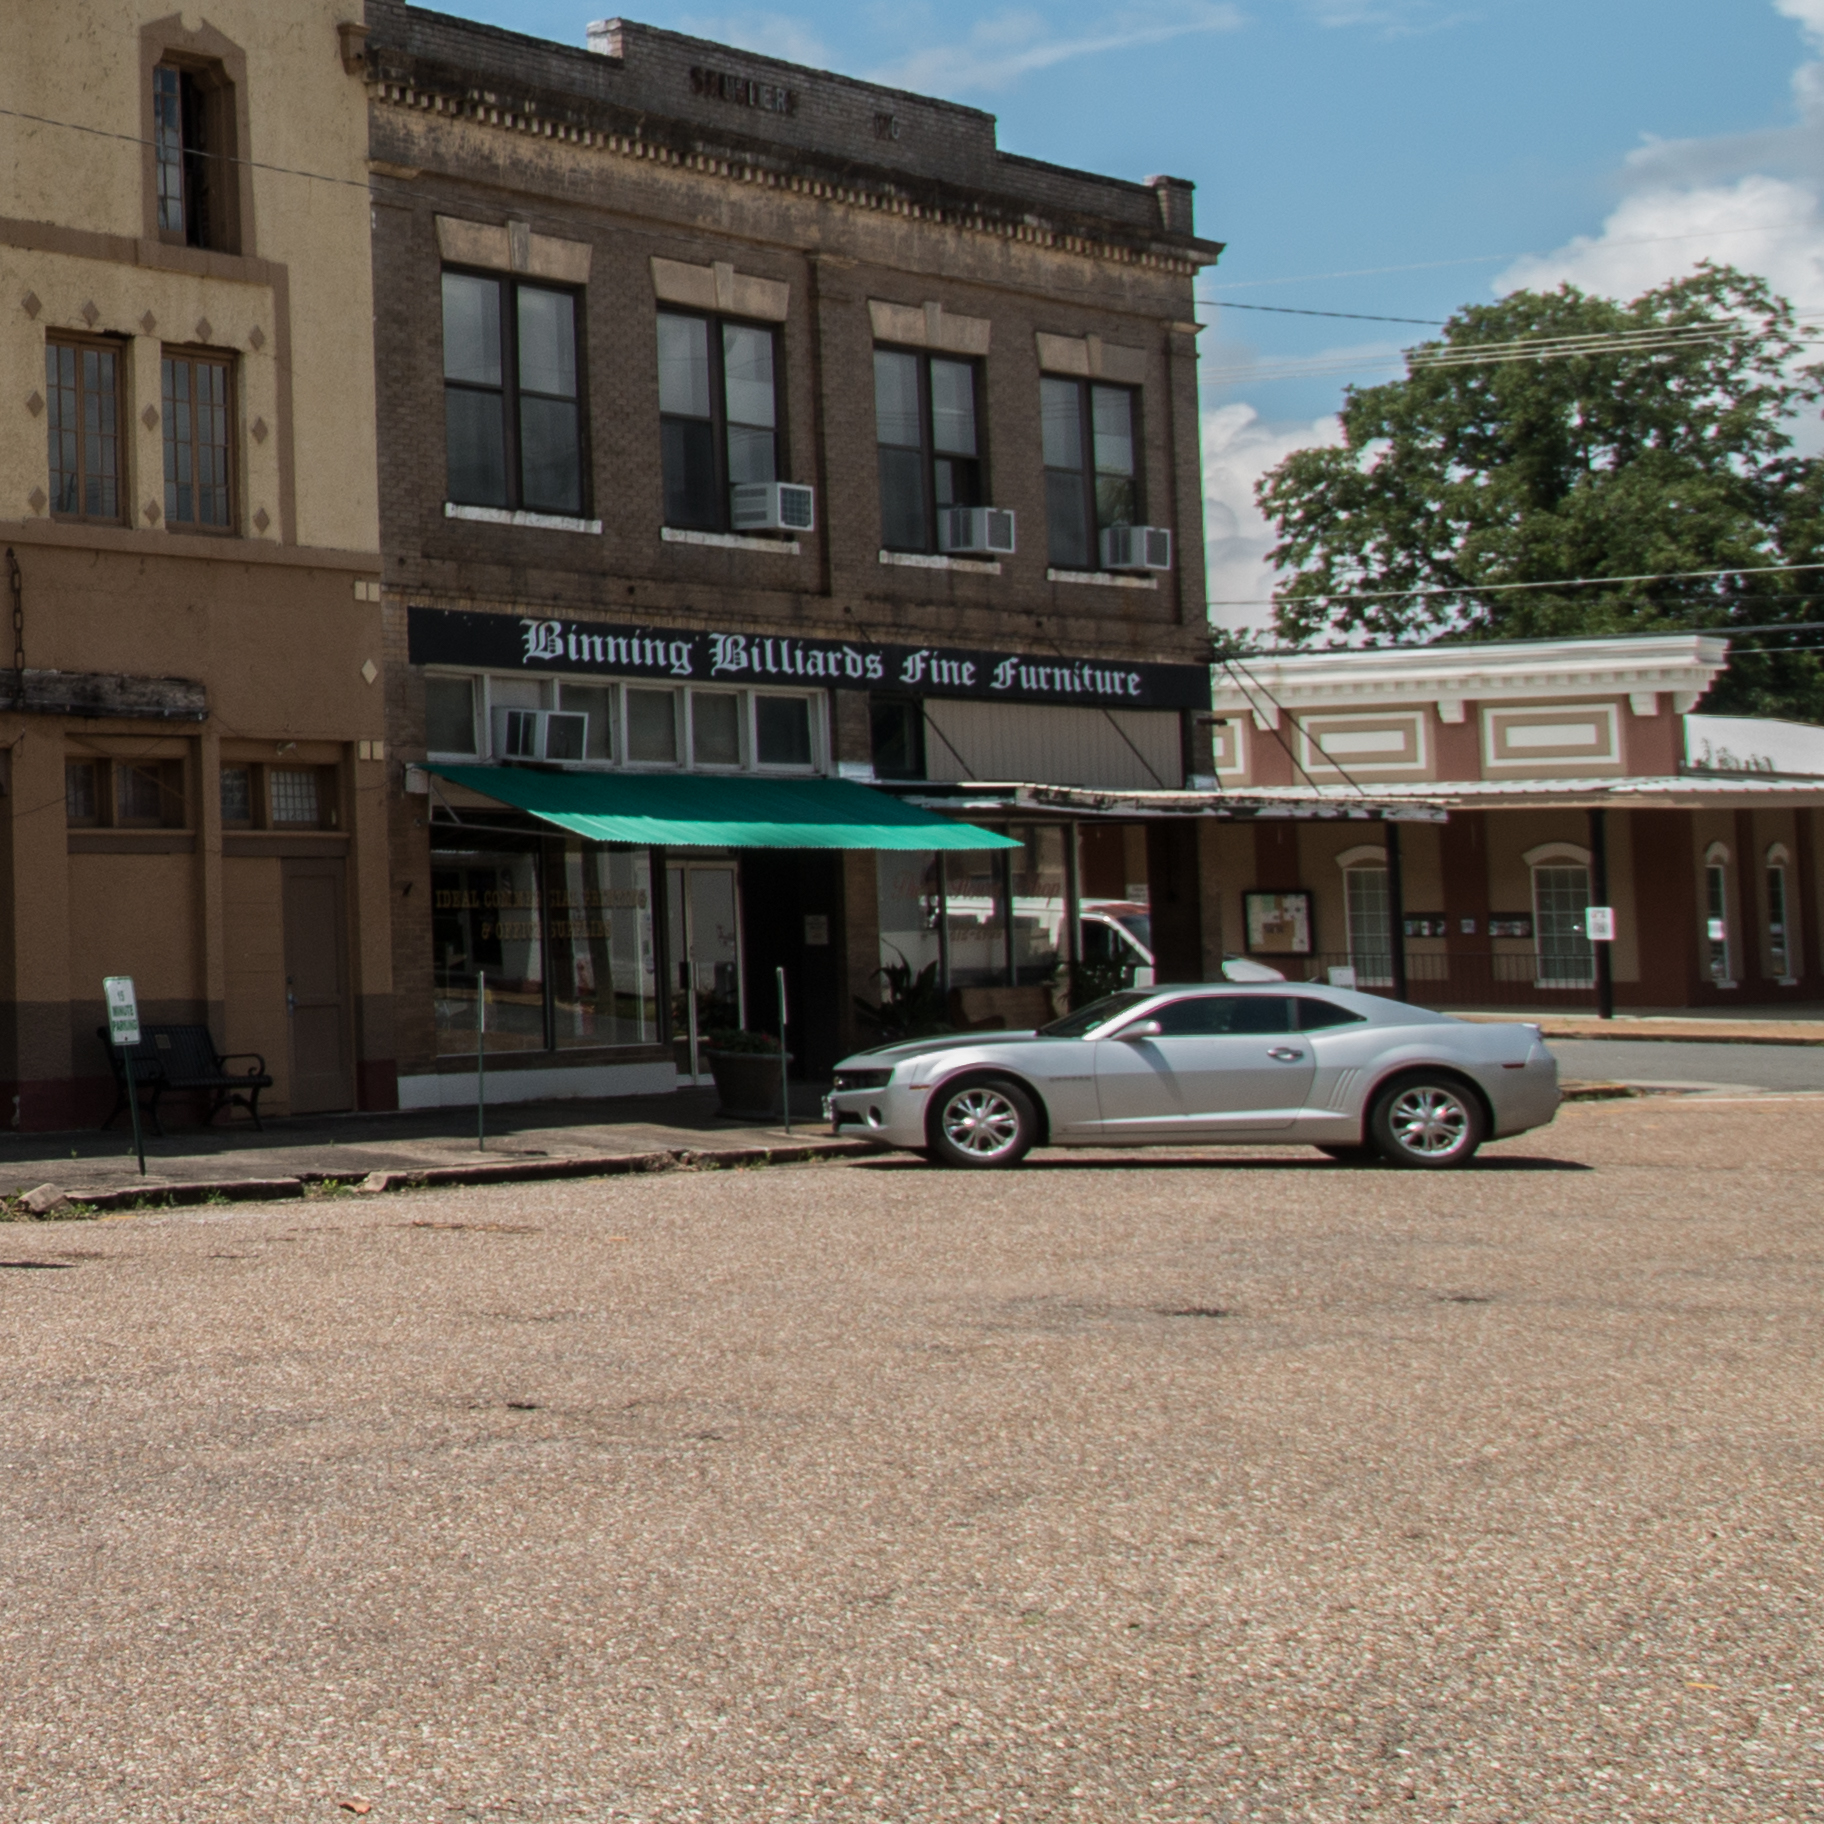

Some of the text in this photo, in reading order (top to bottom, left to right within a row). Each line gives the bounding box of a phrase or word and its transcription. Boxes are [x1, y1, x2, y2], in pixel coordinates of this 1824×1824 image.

[519, 618, 1142, 696] Binning Billiards Fine Furniture
[435, 889, 480, 908] IDEAL
[112, 1005, 134, 1017] MINUTE
[112, 1019, 138, 1032] PARKING
